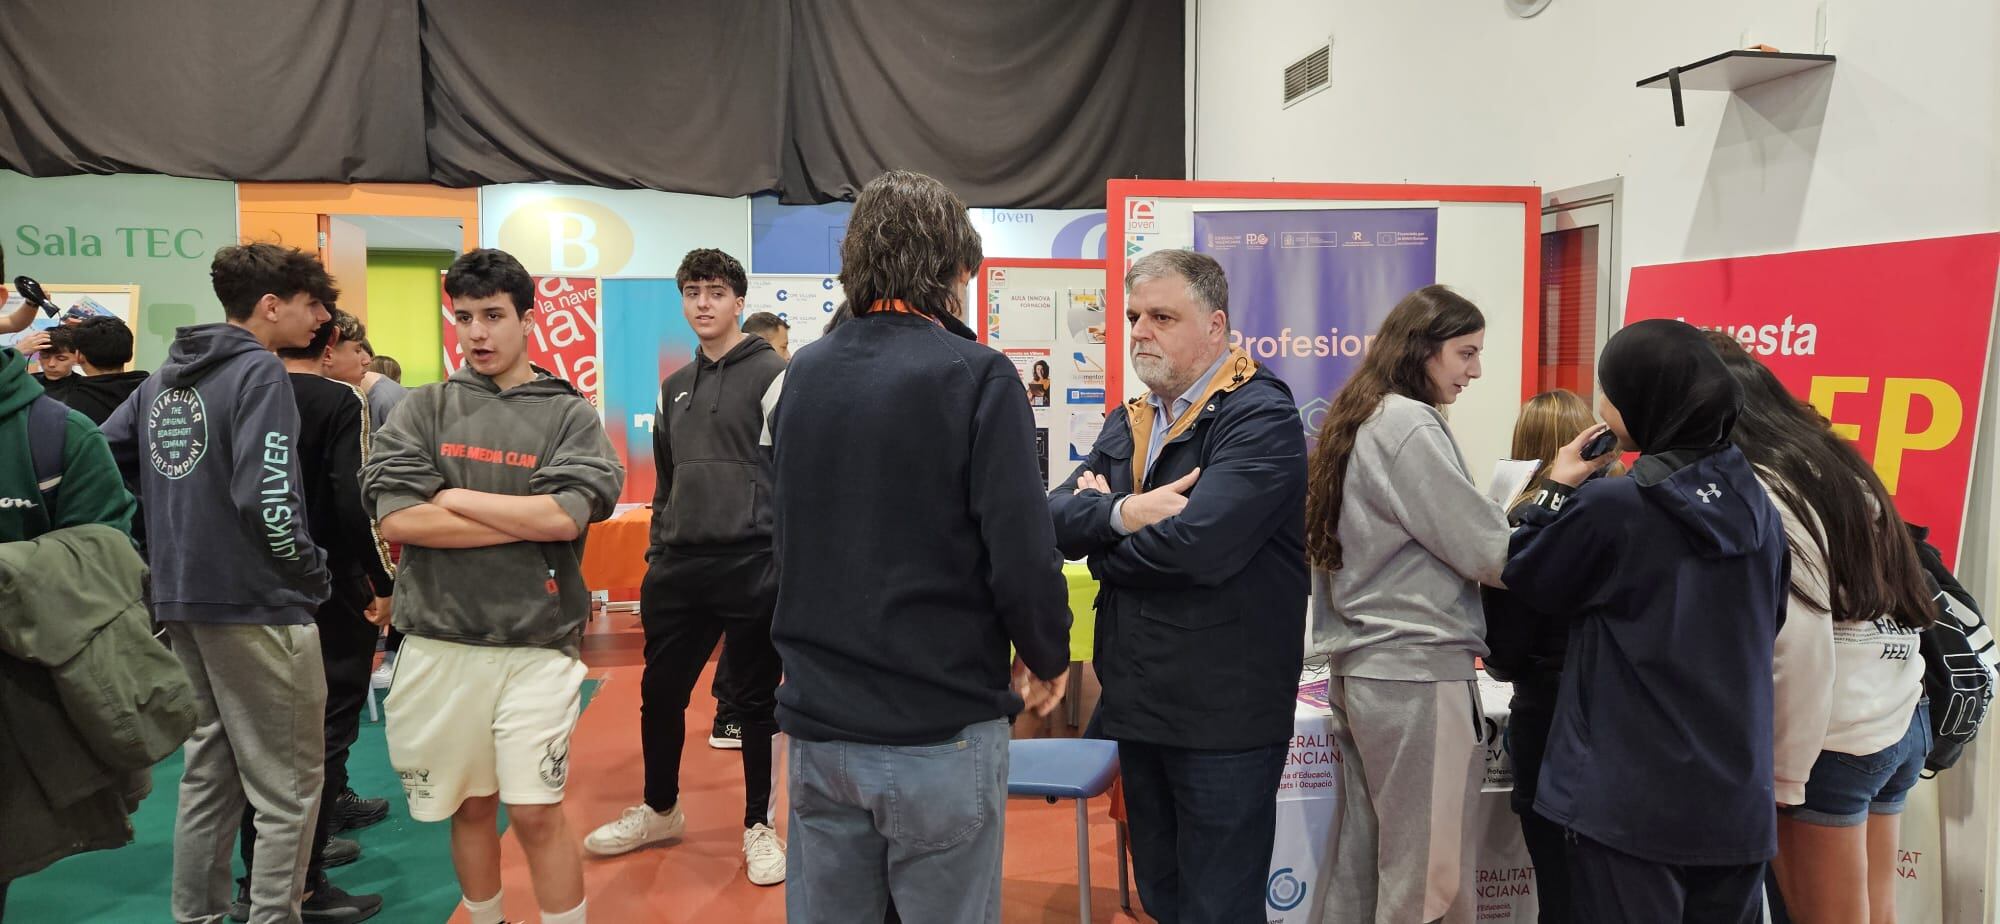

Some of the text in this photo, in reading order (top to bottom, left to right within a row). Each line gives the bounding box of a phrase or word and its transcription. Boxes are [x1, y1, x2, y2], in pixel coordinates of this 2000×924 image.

[991, 208, 1034, 224] Joven
[1128, 219, 1155, 230] joven
[16, 225, 205, 259] Sala TEC
[545, 210, 600, 273] B
[538, 286, 597, 315] la nave
[171, 406, 183, 415] THE
[1808, 375, 1963, 496] FP
[440, 442, 537, 469] FIVE MEDIA CLAN
[260, 431, 300, 561] UIKSILVER
[1880, 643, 1911, 661] FEEL
[1288, 734, 1340, 749] ERALIT
